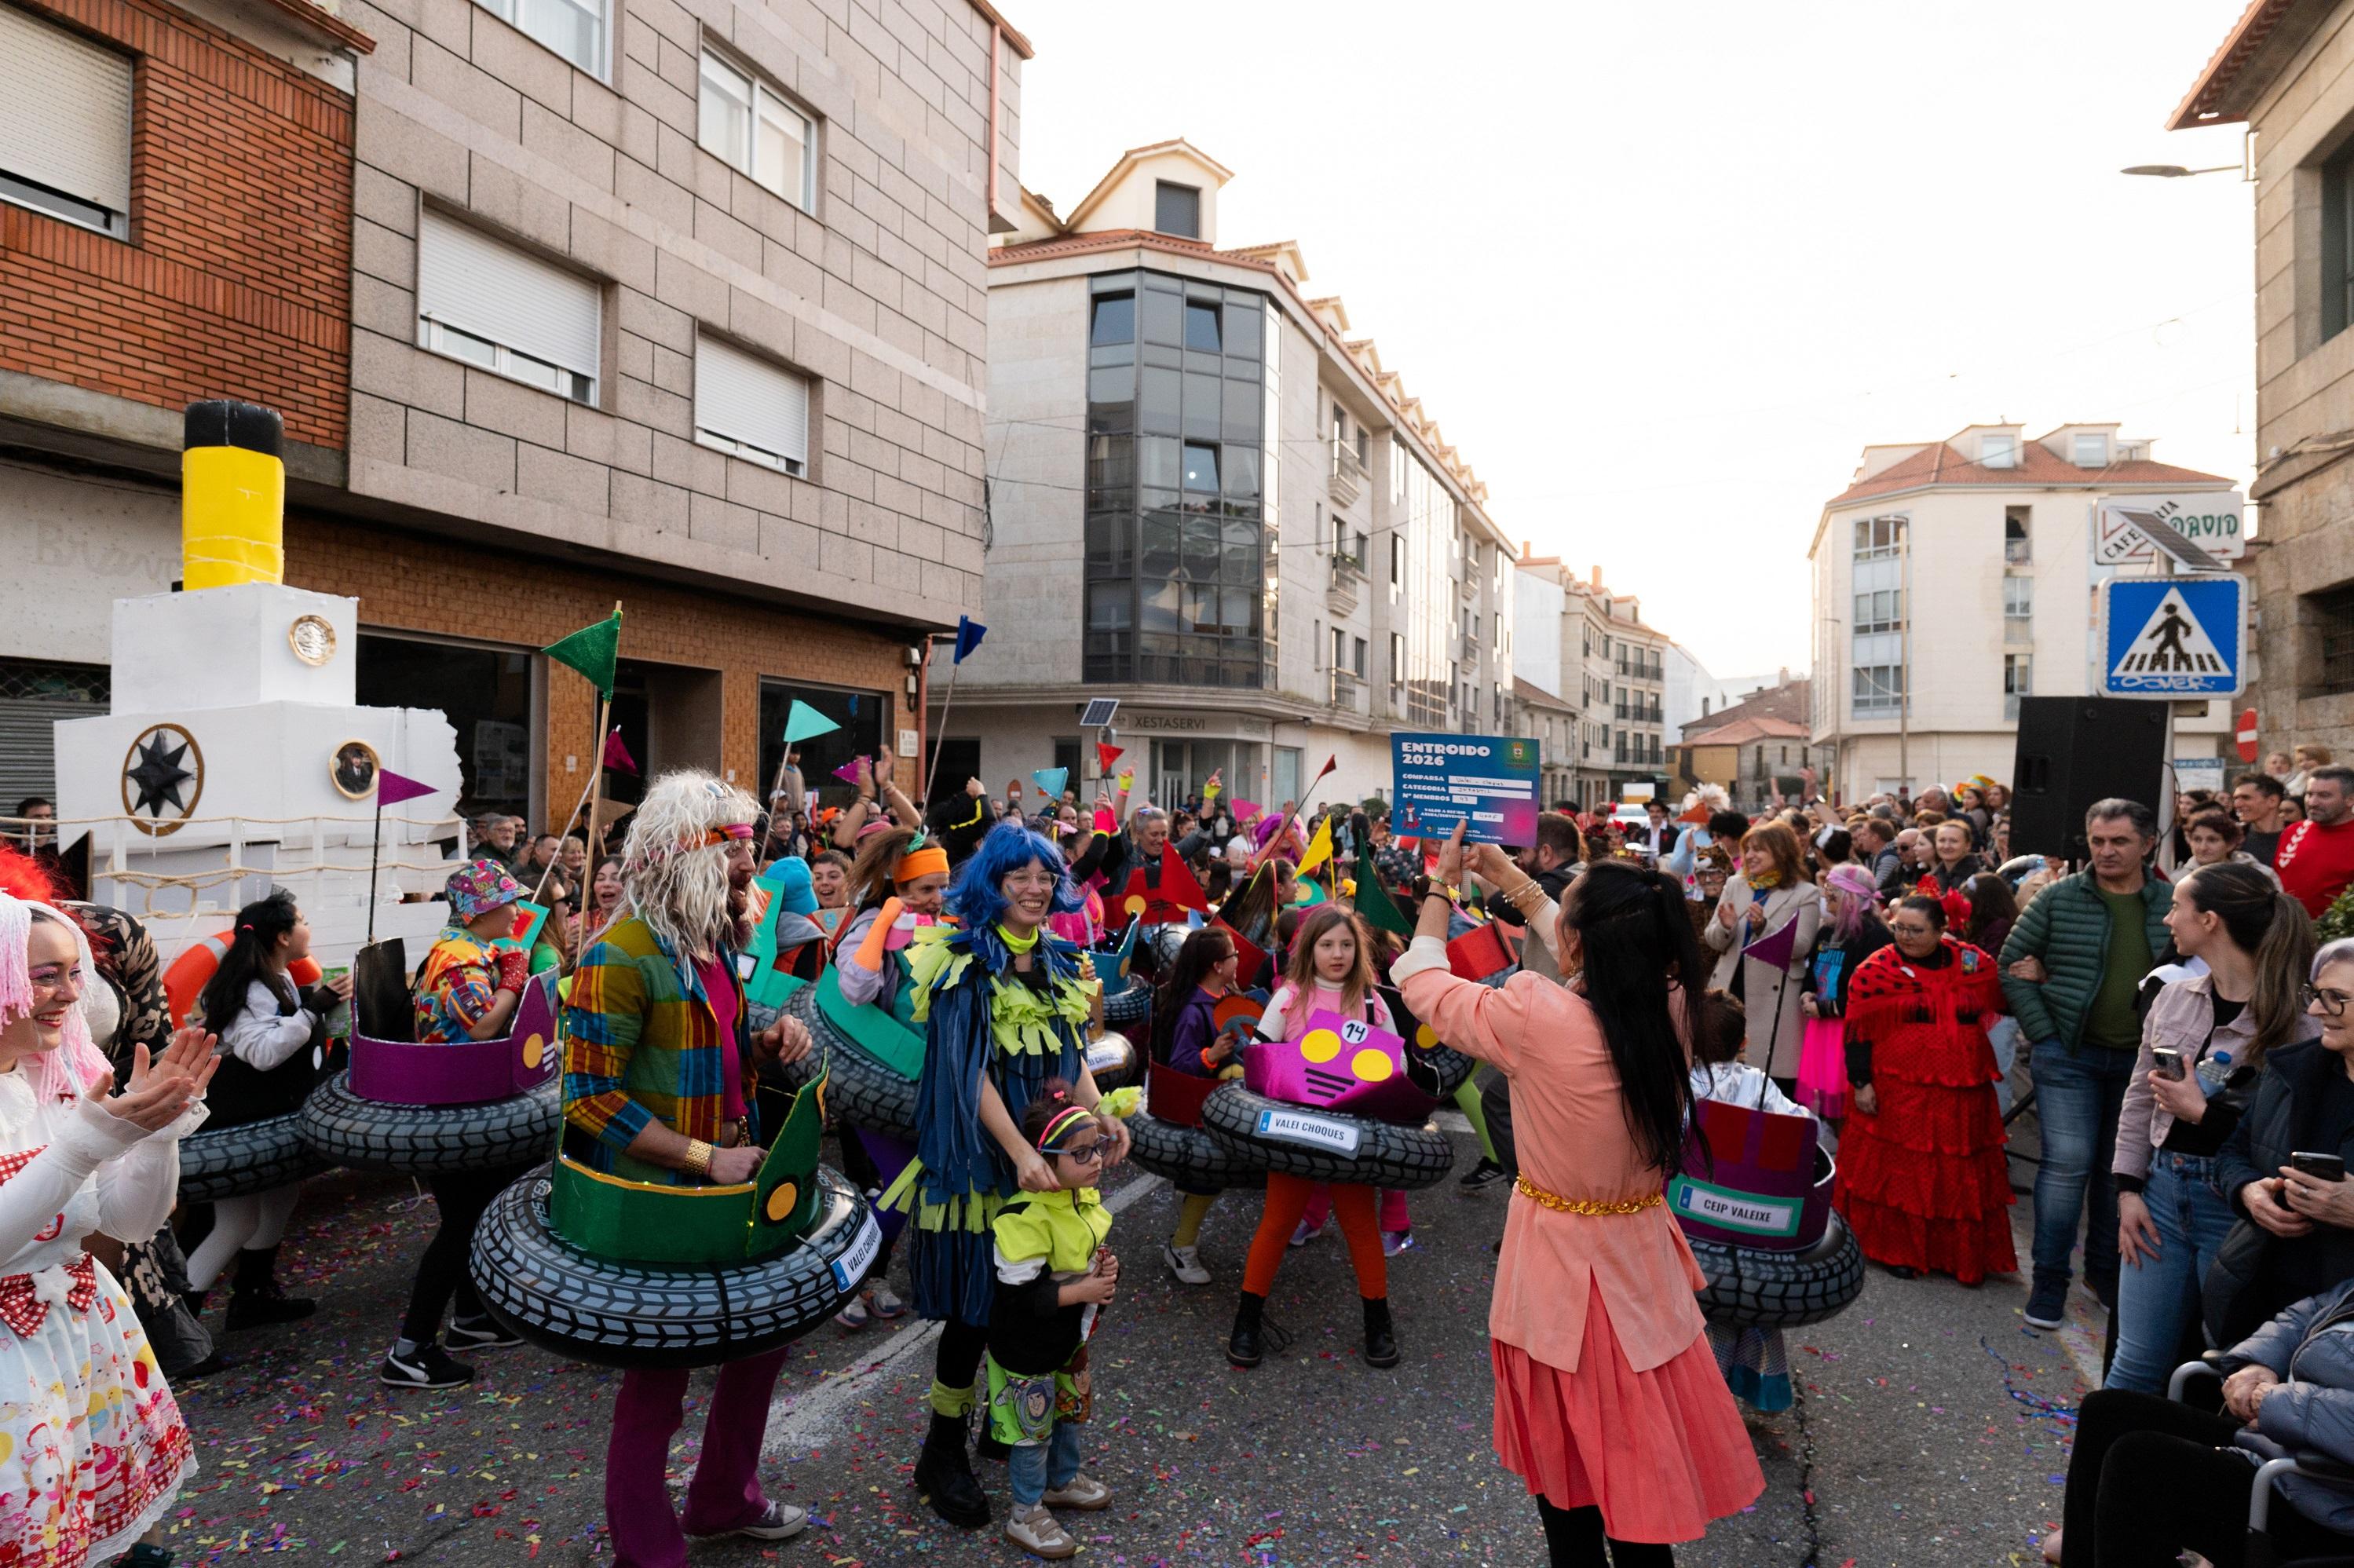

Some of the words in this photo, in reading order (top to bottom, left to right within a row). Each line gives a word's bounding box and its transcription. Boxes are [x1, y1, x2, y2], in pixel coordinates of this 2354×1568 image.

[2170, 514, 2239, 539] DAVID
[1135, 716, 1206, 729] XESTASERVI
[1402, 742, 1490, 757] ENTROIDO
[1402, 754, 1445, 766] 2026
[1346, 1022, 1366, 1041] 14
[1275, 1117, 1299, 1130] VALEI
[1301, 1121, 1345, 1140] CHOQUES
[1703, 1199, 1728, 1213] CEIP
[1731, 1205, 1772, 1223] VALEIXE
[847, 1248, 865, 1272] VALEI
